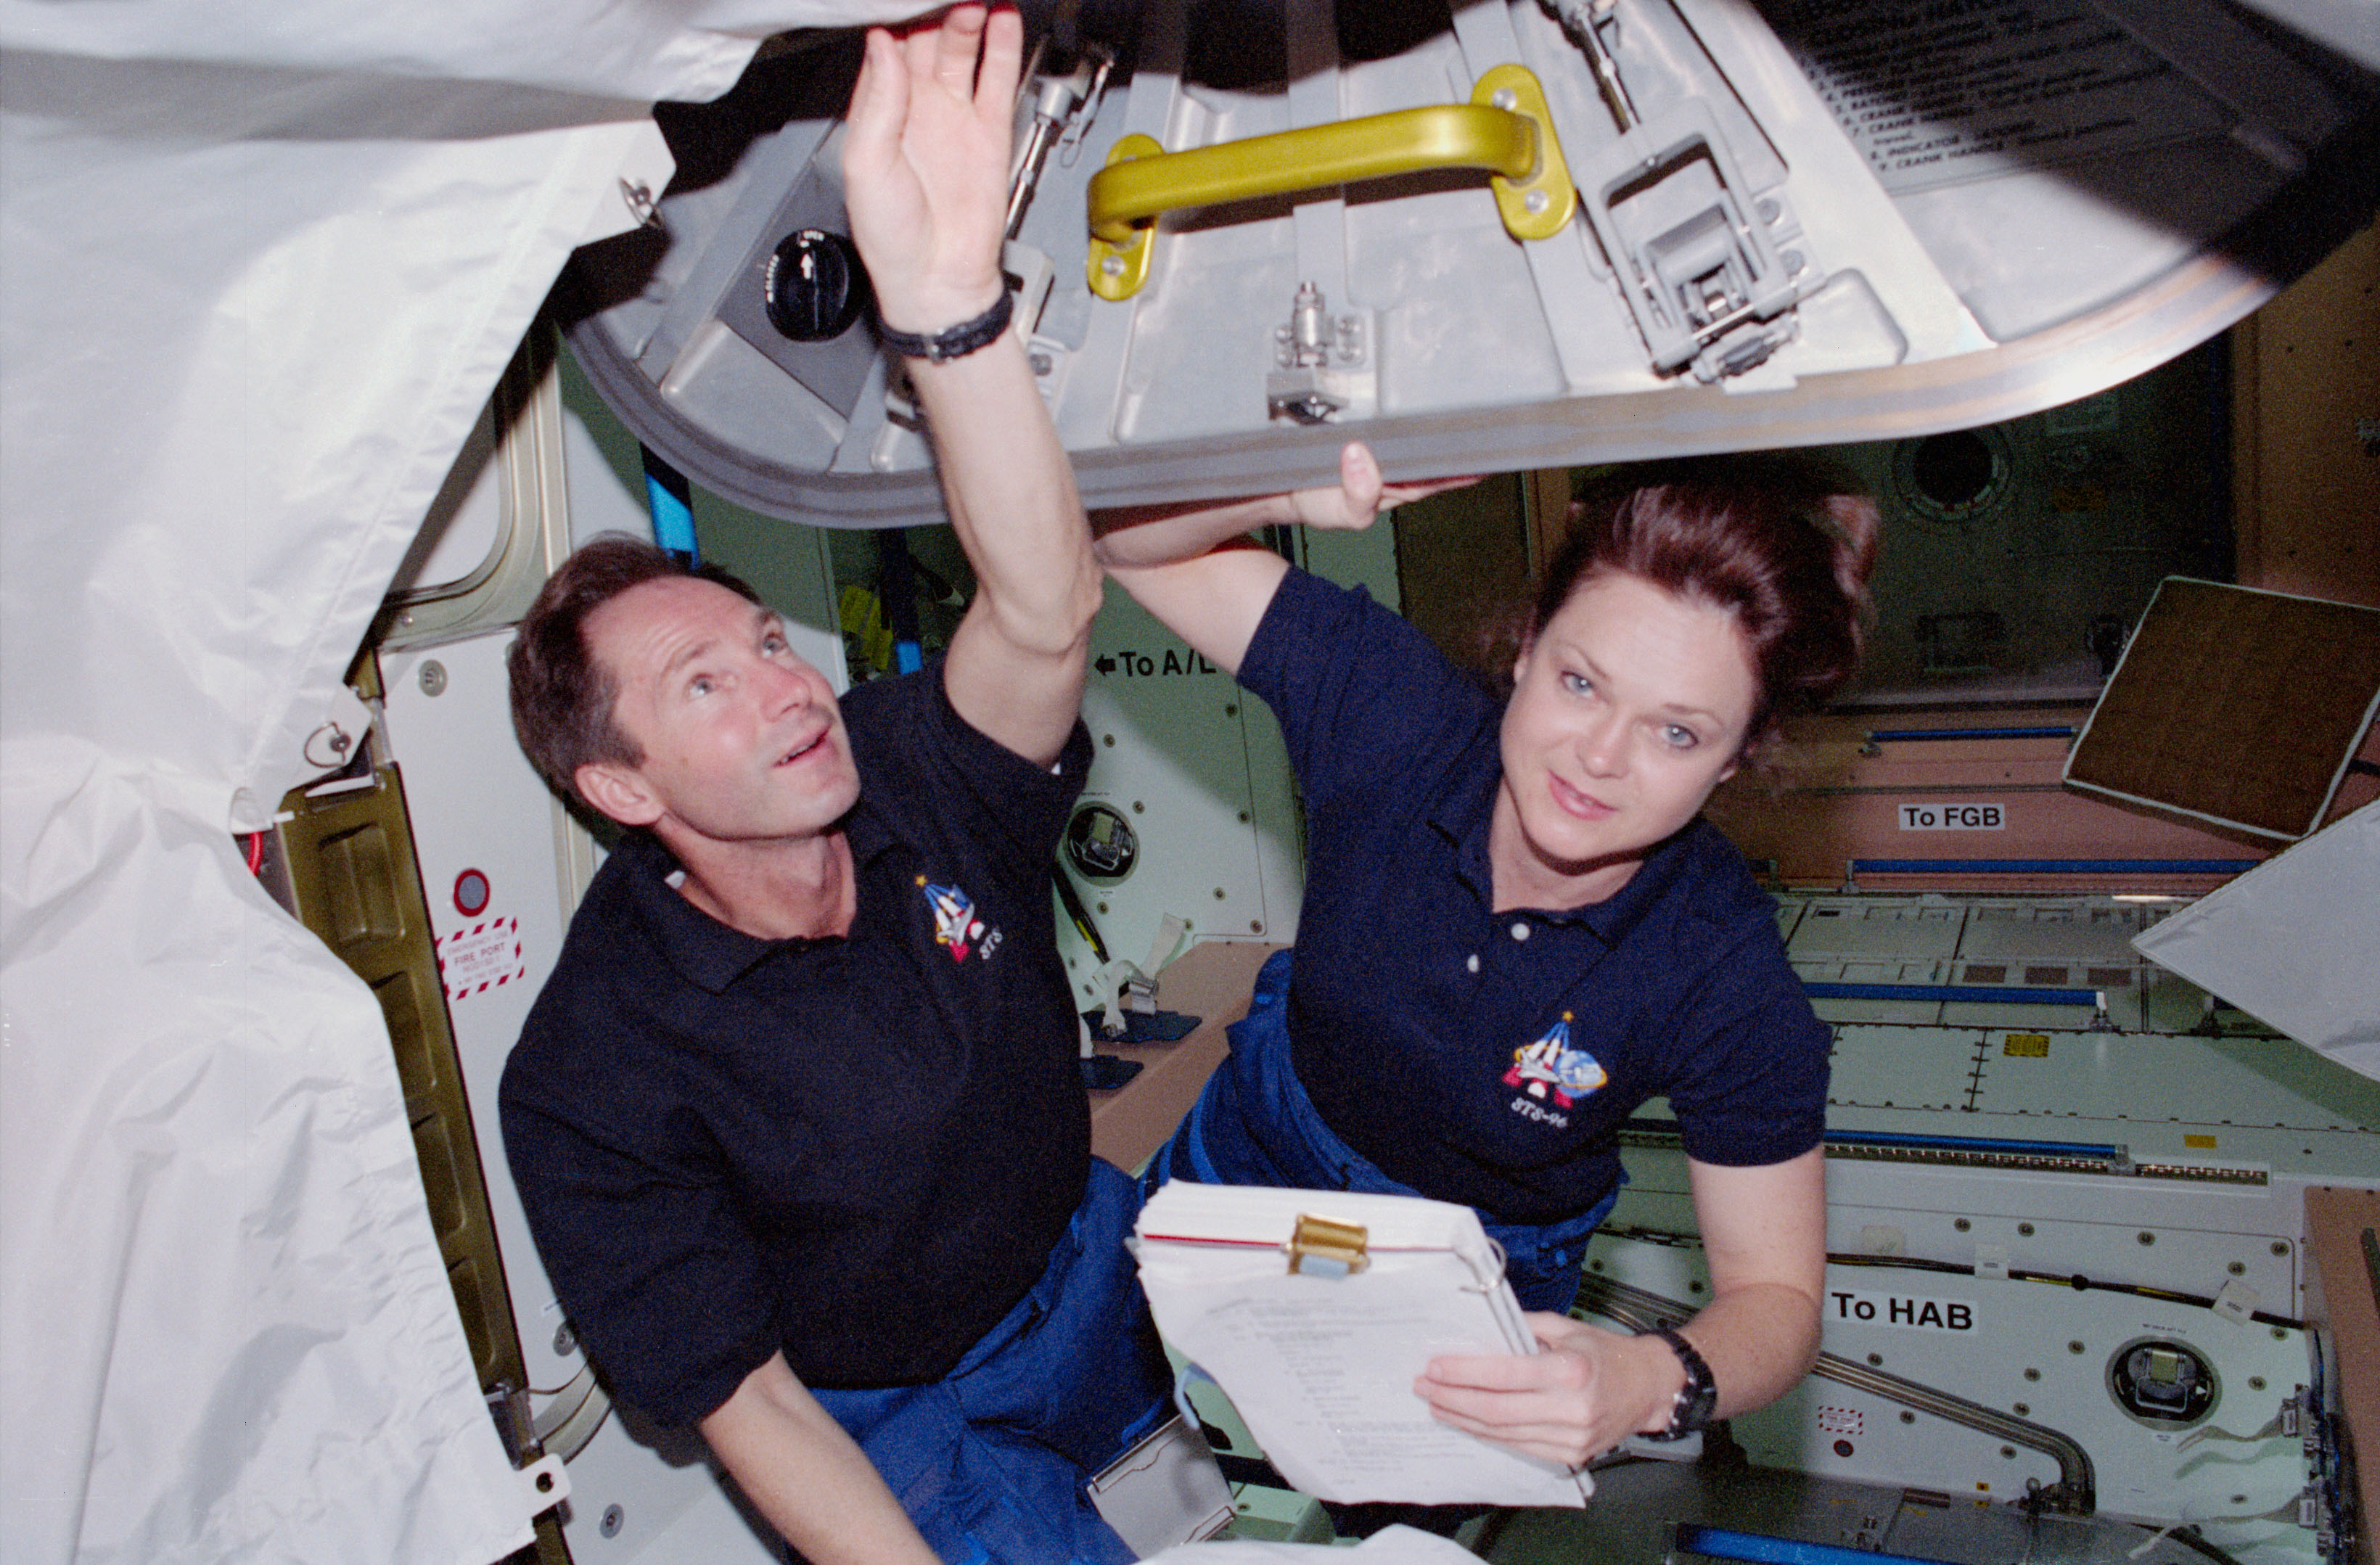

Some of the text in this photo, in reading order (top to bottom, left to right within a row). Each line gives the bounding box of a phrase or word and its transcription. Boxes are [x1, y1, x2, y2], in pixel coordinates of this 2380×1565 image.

[1119, 649, 1217, 677] To A/L
[1904, 807, 2001, 827] To FGB
[454, 951, 476, 966] FIRE
[480, 942, 506, 957] PORT
[1511, 1097, 1567, 1128] STS-96
[1831, 1291, 1972, 1330] To HAB
